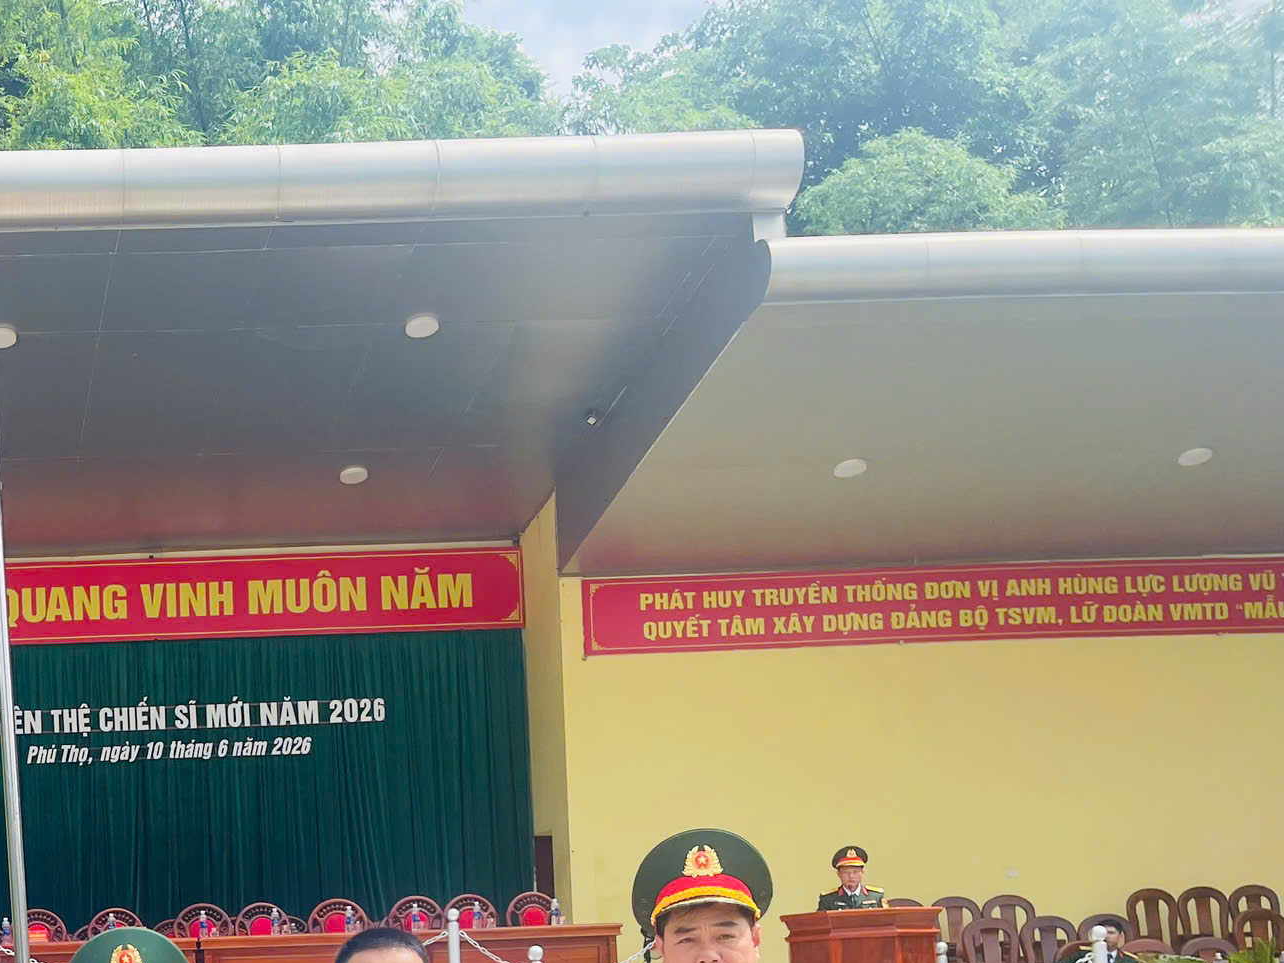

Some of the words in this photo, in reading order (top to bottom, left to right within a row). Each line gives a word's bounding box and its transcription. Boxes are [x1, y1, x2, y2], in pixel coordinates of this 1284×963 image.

[141, 581, 233, 618] VINH
[248, 570, 367, 614] MUÔN
[381, 567, 472, 610] NĂM
[640, 589, 696, 611] PHÁT
[703, 590, 745, 608] HUY
[752, 581, 837, 606] TRUYỀN
[844, 578, 918, 603] THỐNG
[924, 580, 970, 599] ĐƠN
[978, 580, 998, 600] VỊ
[1006, 578, 1051, 596] ANH
[1059, 574, 1118, 594] HÙNG
[1125, 574, 1165, 596] LỰC
[1173, 573, 1242, 595] LƯỢNG
[1249, 570, 1275, 590] VŨ
[644, 614, 711, 641] QUYẾT
[717, 615, 765, 636] TÂM
[773, 613, 815, 634] XÂY
[823, 612, 884, 635] DỰNG
[891, 604, 952, 629] ĐẢNG
[959, 605, 988, 630] BỘ
[996, 607, 1063, 625] TSVM,
[1070, 601, 1098, 623] LỮ
[1103, 601, 1163, 622] ĐOÀN
[51, 704, 91, 736] THỆ
[100, 697, 165, 731] CHIẾN
[175, 700, 197, 728] SĨ
[206, 697, 250, 728] MỚI
[260, 696, 319, 726] NĂM
[330, 698, 385, 723] 2026
[27, 745, 57, 764] Phú
[62, 745, 92, 765] Thọ,
[101, 741, 139, 762] ngày
[147, 742, 163, 759] 10
[170, 740, 213, 759] tháng
[218, 740, 228, 757] 6
[233, 737, 267, 756] năm
[272, 737, 311, 755] 2026
